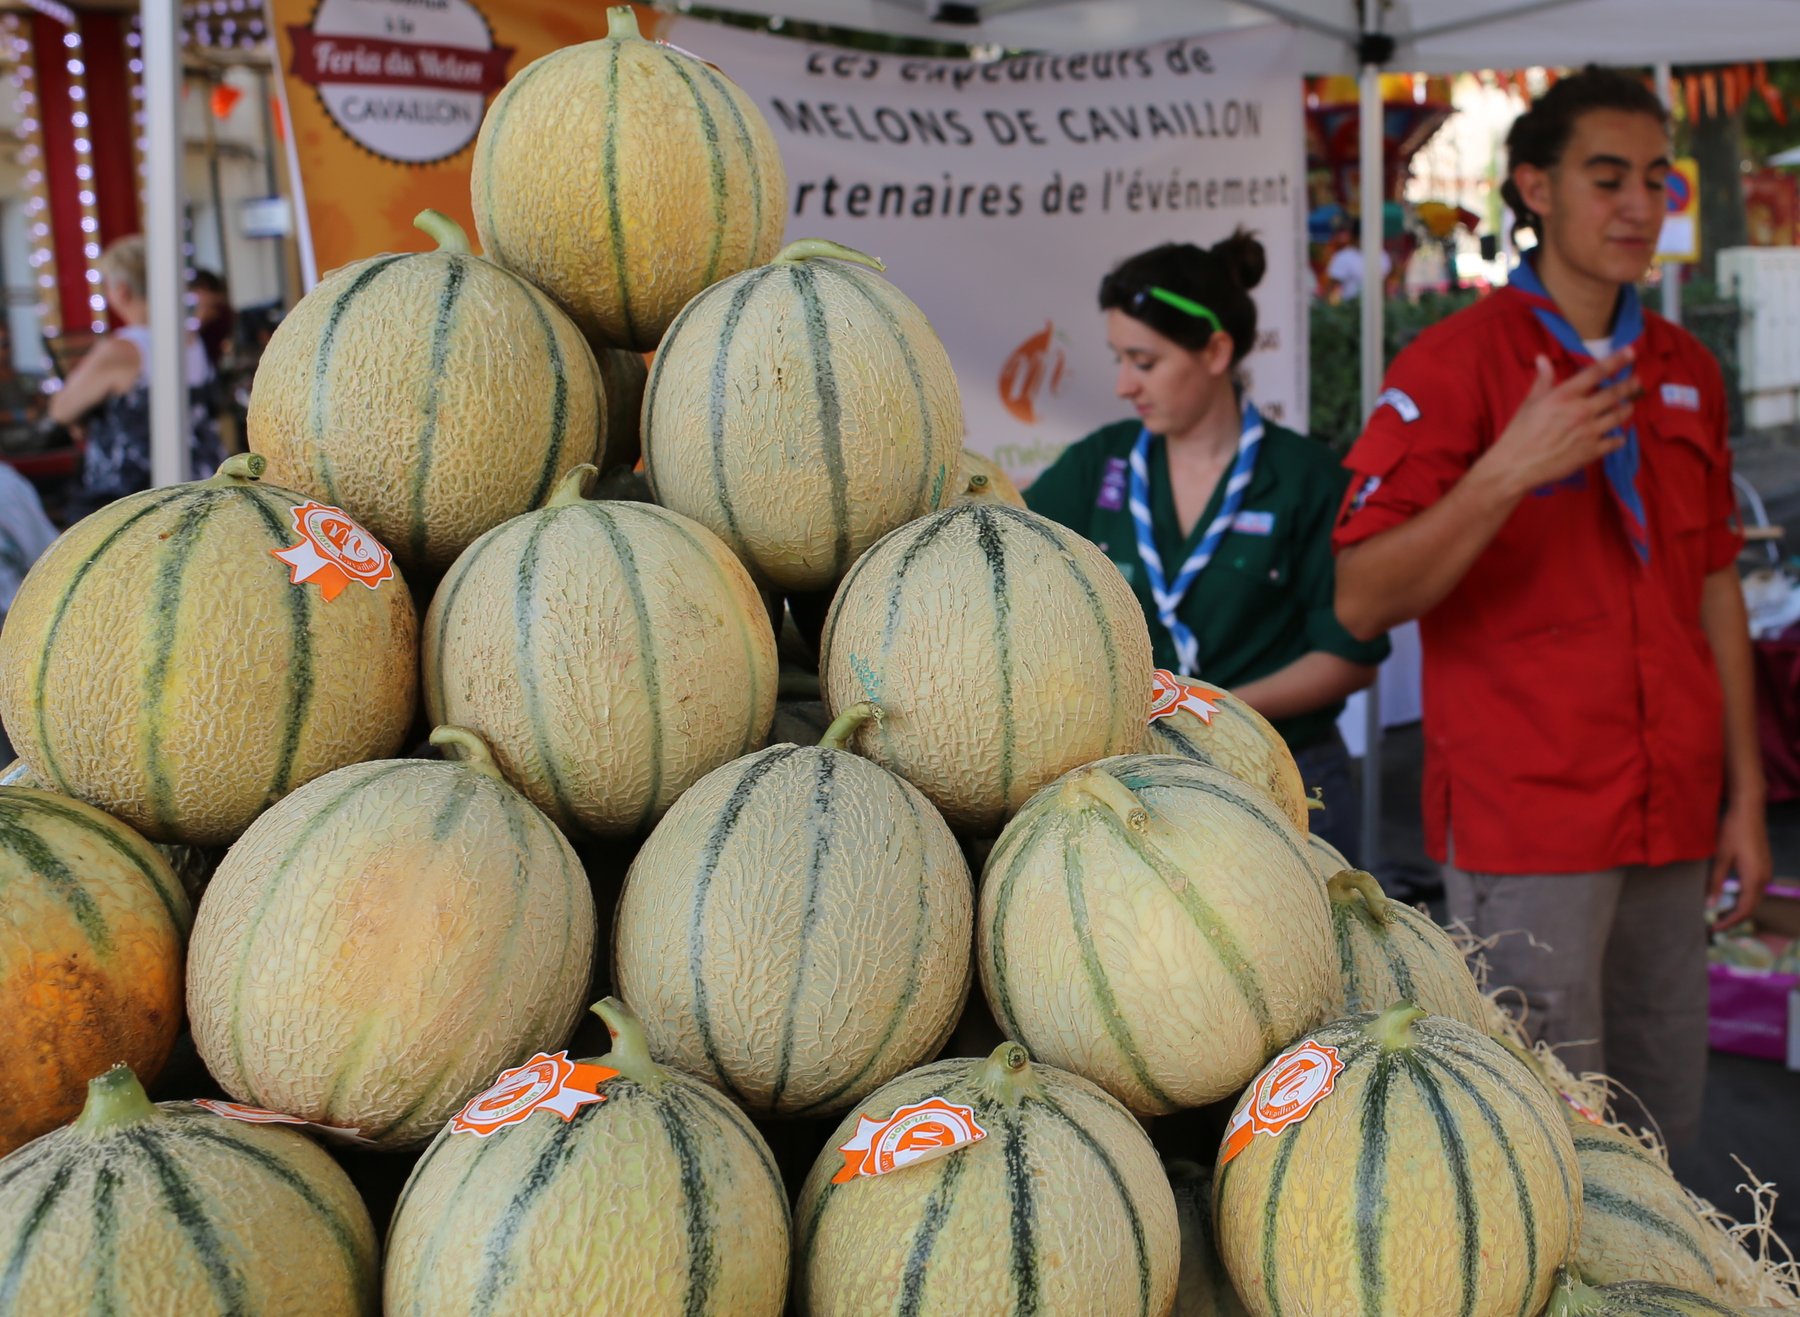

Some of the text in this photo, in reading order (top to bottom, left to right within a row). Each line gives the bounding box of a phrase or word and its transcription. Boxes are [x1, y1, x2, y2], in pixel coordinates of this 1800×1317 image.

[1165, 38, 1217, 76] de
[341, 94, 474, 123] CAVAILLON
[772, 97, 1263, 146] MELONS DE CAVAILLON
[794, 166, 1288, 218] rtenaires de l'événement
